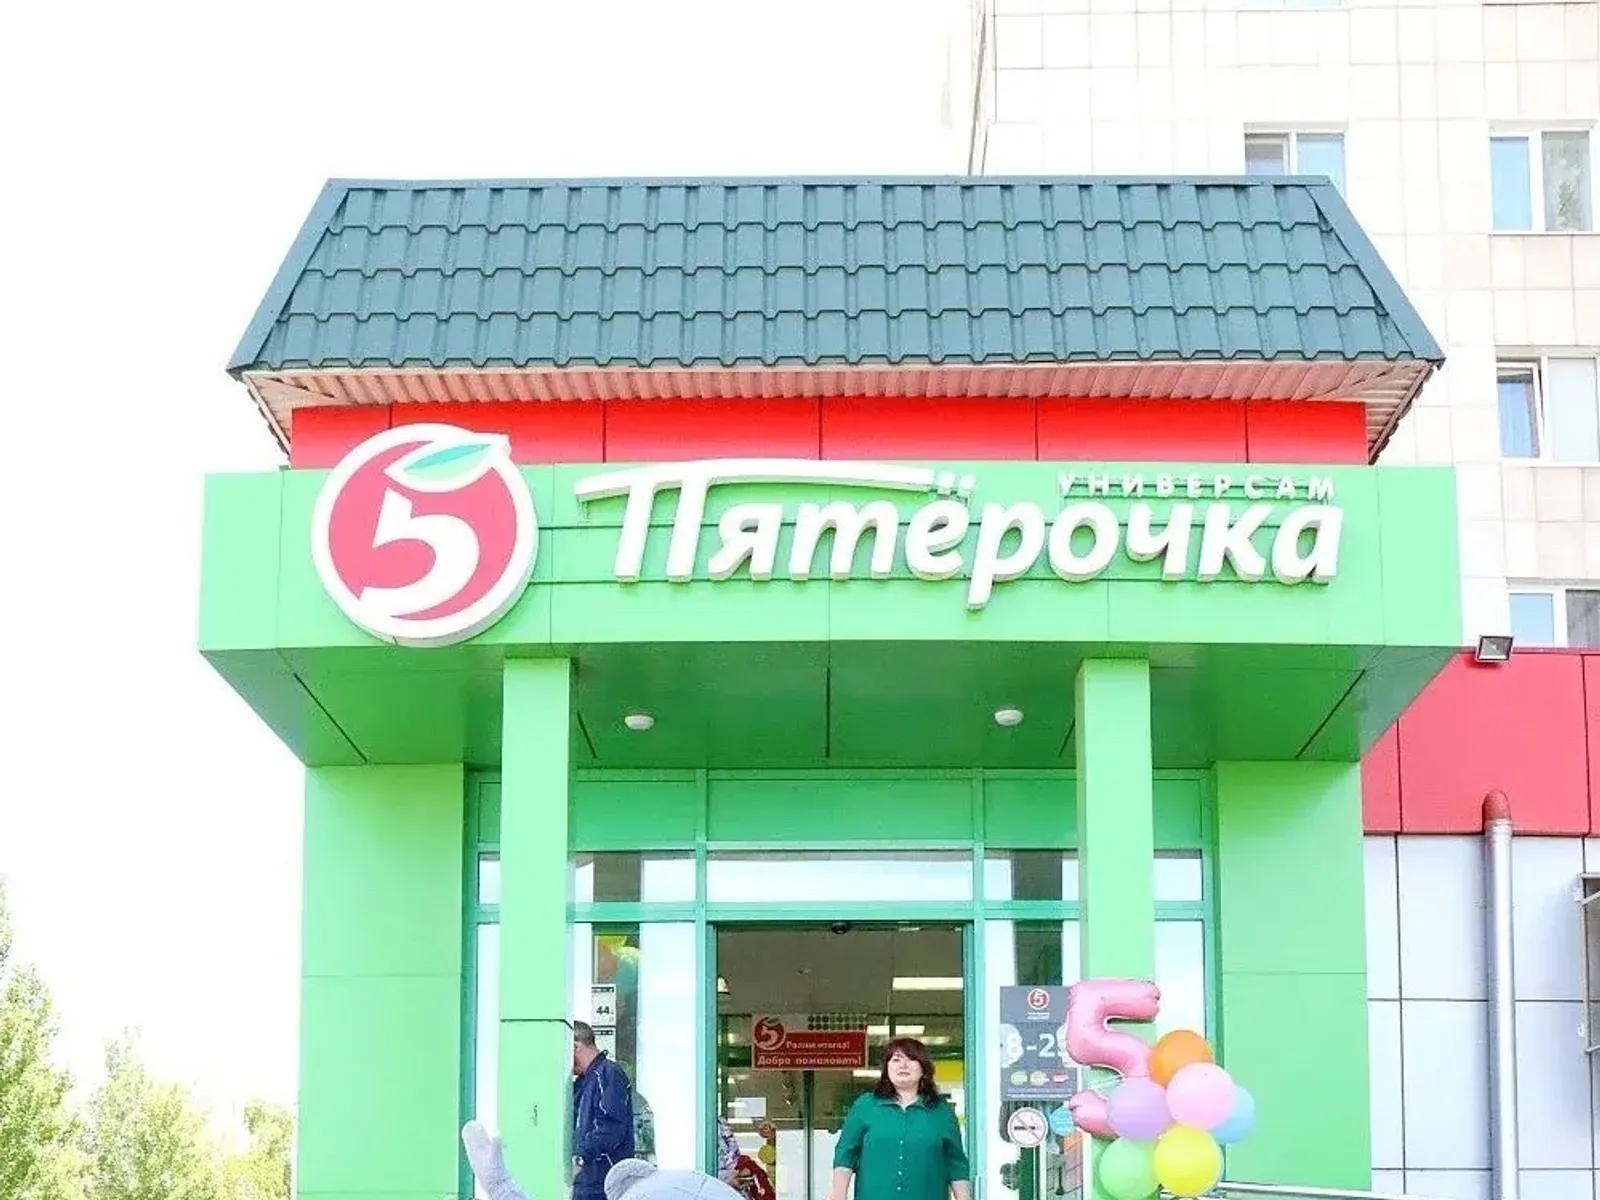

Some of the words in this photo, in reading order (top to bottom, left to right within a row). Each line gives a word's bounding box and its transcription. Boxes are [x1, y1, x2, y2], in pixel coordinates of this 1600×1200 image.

[1058, 471, 1336, 500] УНИВЕРСАМ
[358, 487, 481, 622] 5
[574, 458, 1344, 610] Пятёрочка
[757, 1056, 791, 1067] Добро
